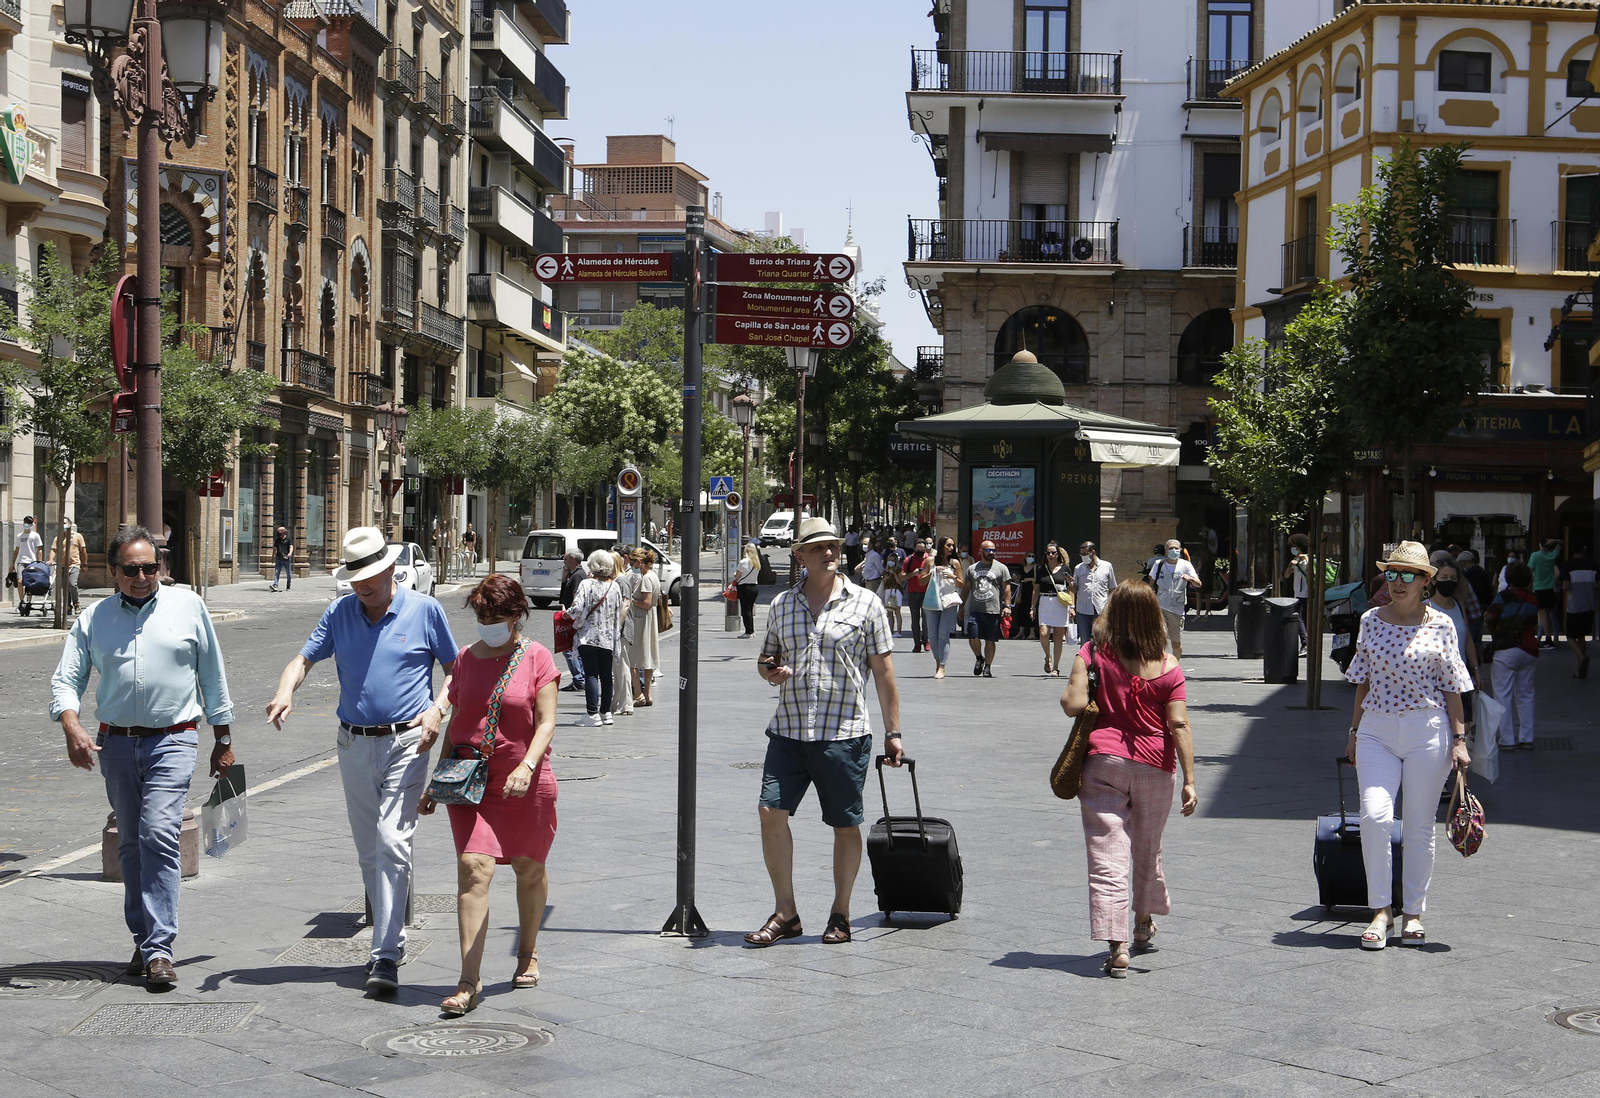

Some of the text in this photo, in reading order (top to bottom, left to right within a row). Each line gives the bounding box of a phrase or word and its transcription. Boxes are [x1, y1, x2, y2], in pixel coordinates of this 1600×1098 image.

[62, 80, 89, 93] HIPOTECAS
[625, 257, 659, 265] Hércules
[614, 269, 638, 277] Hércules
[764, 292, 811, 302] Monumental
[747, 303, 792, 313] Monumental
[735, 321, 761, 329] Capilla
[791, 323, 810, 331] José
[765, 333, 782, 341] José
[784, 334, 810, 343] Chapel
[1548, 415, 1582, 434] LA
[891, 443, 932, 451] VERTICE
[1108, 443, 1126, 454] ABC
[1147, 446, 1163, 456] ABC
[1061, 473, 1099, 484] PRENSA
[407, 478, 419, 490] TGB
[983, 531, 1024, 540] REBAJAS
